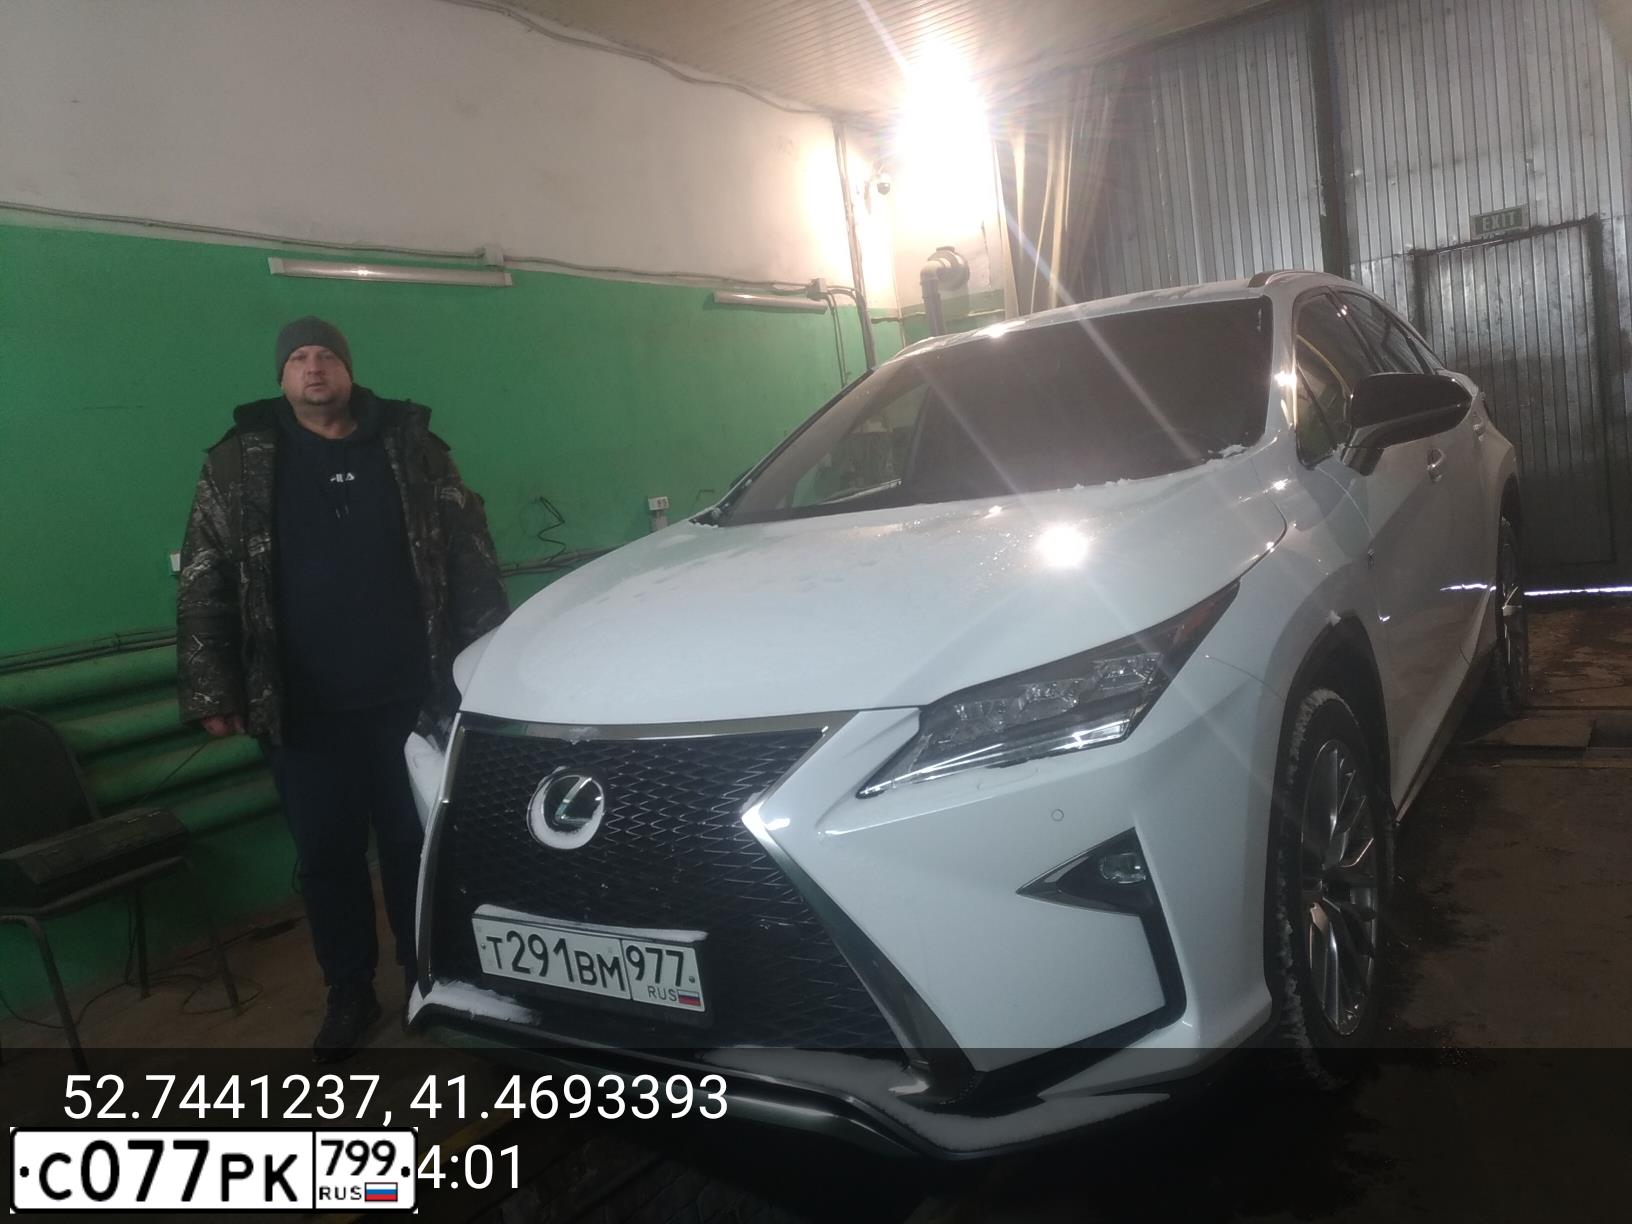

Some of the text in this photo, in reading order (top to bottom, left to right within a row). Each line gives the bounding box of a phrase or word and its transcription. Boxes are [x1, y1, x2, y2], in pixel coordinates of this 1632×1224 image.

[1482, 211, 1517, 231] EXIT
[626, 945, 684, 987] 977
[647, 986, 678, 1001] RUS
